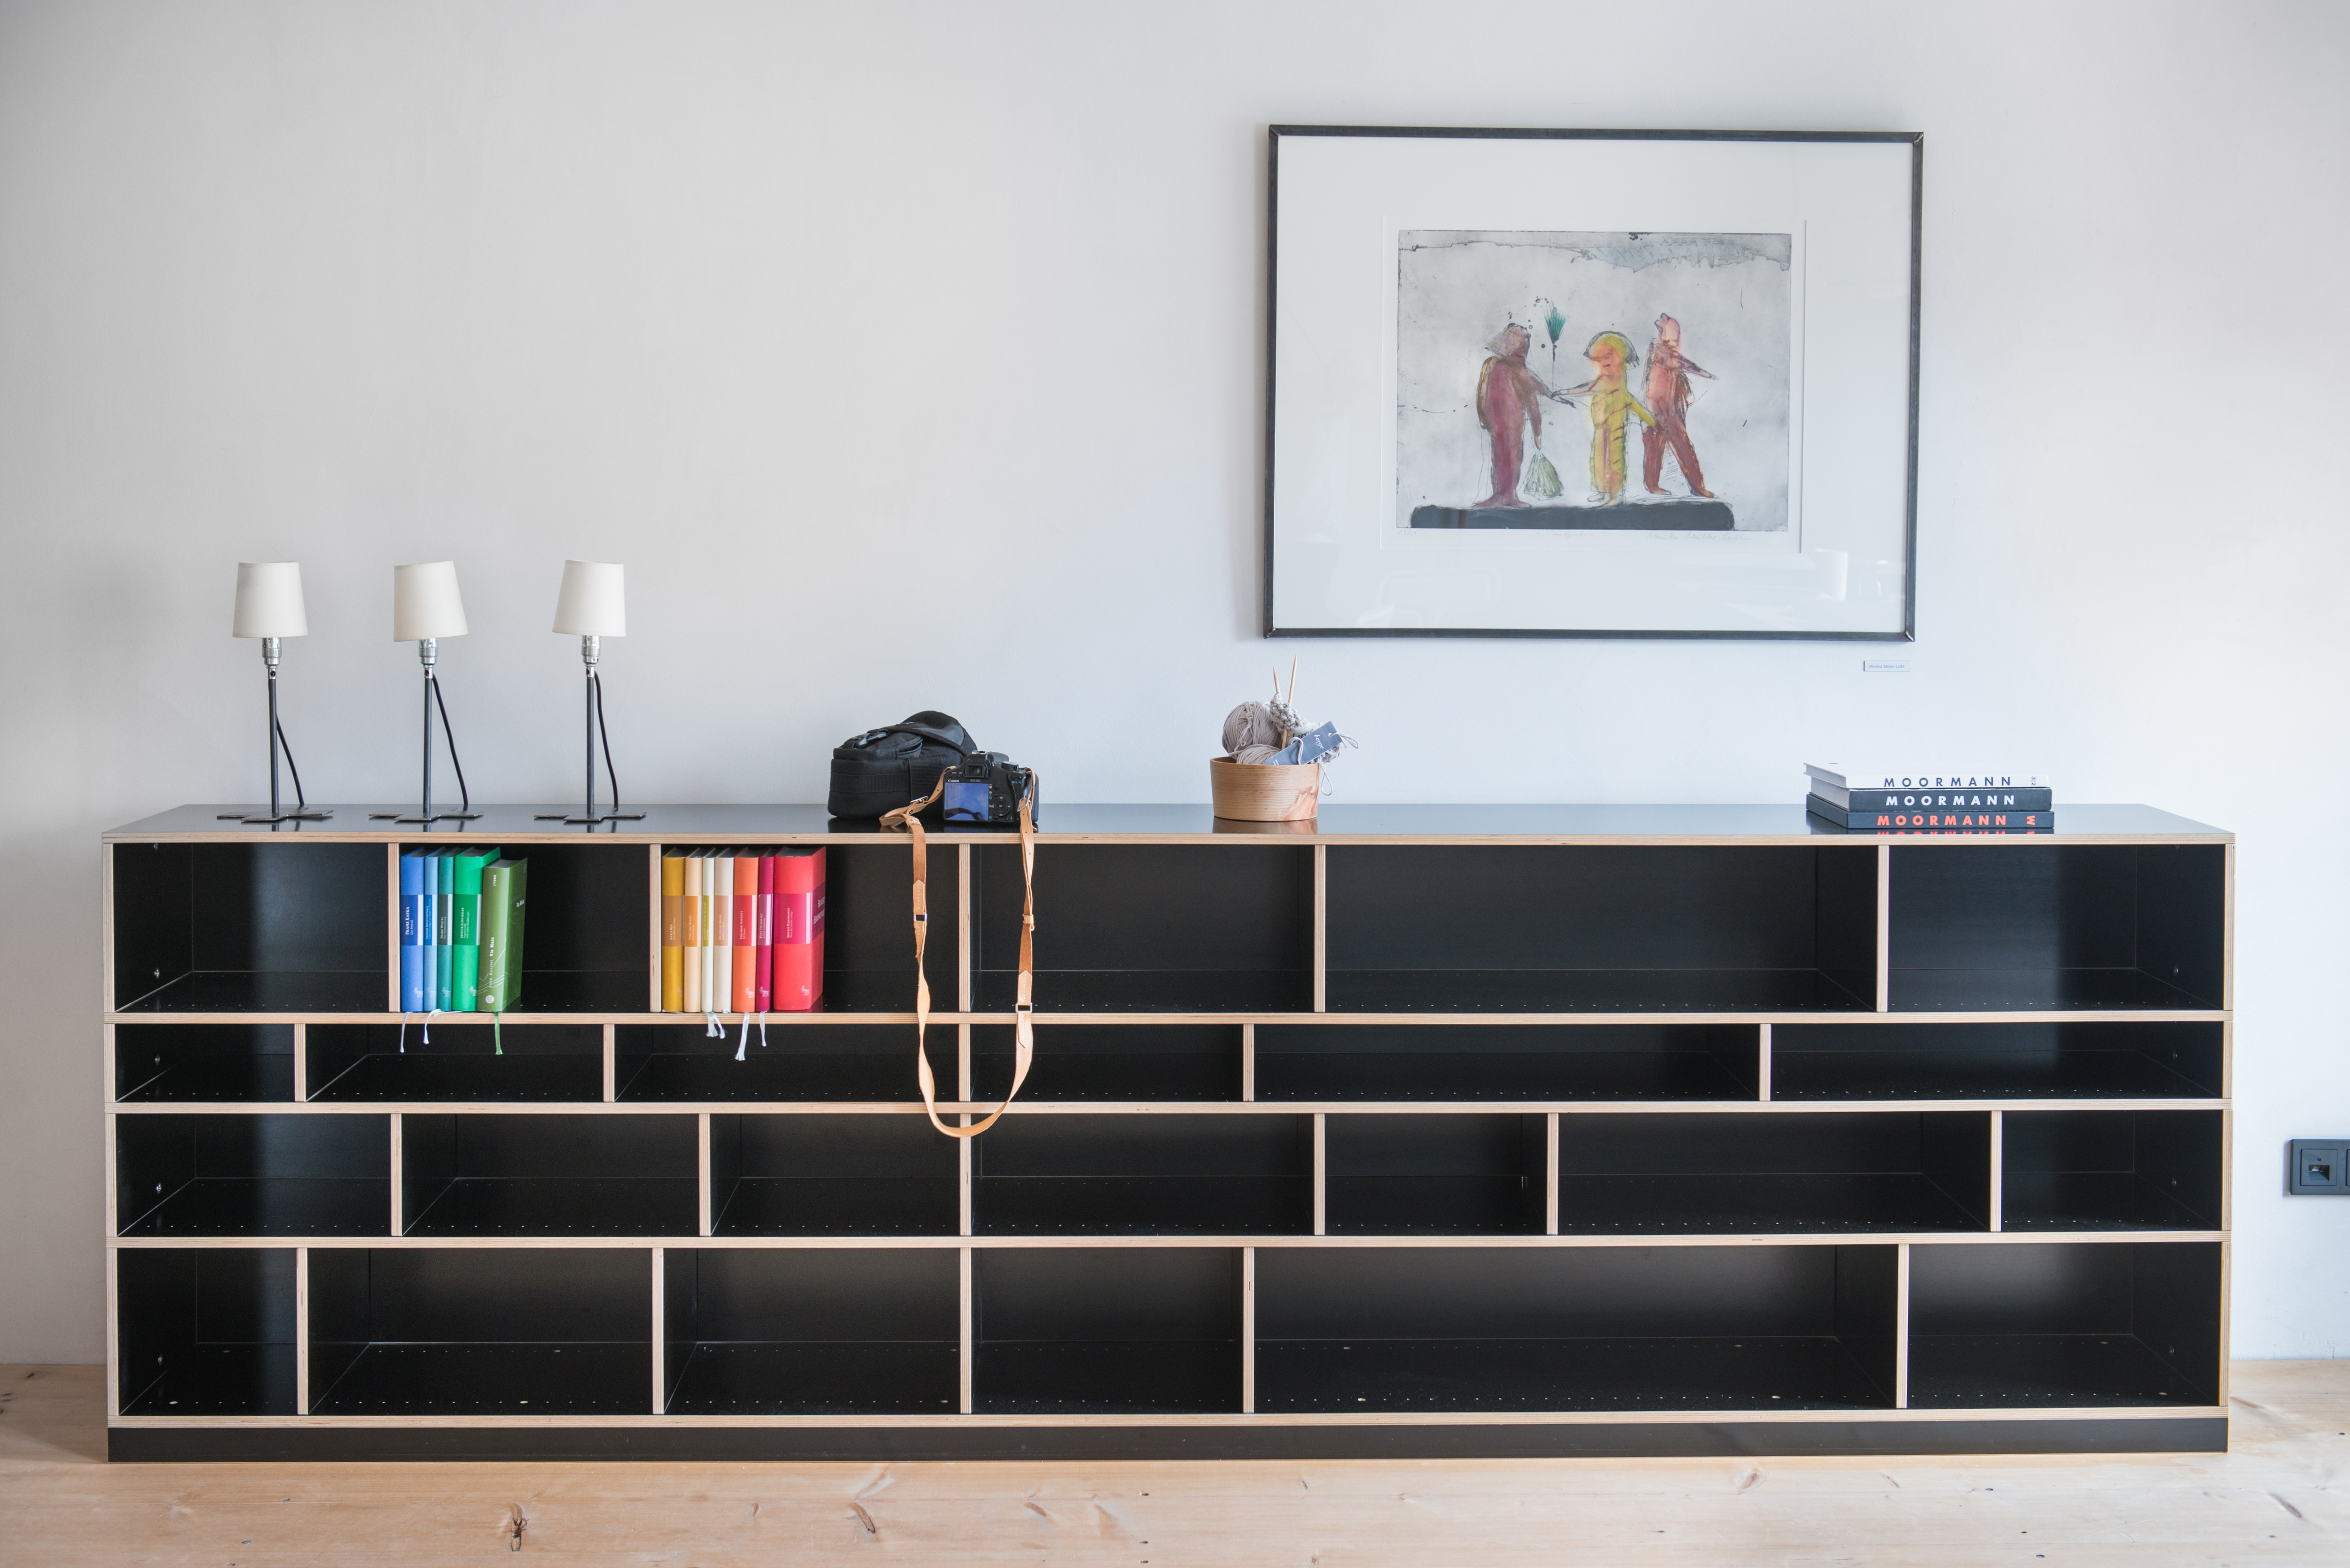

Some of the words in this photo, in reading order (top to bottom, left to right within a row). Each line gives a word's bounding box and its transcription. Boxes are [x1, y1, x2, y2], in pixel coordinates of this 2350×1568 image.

[1314, 734, 1324, 749] berge
[1884, 777, 2010, 787] MOORMANN
[1886, 795, 2014, 805] MOORMANN
[1877, 815, 2006, 826] MOORMANN
